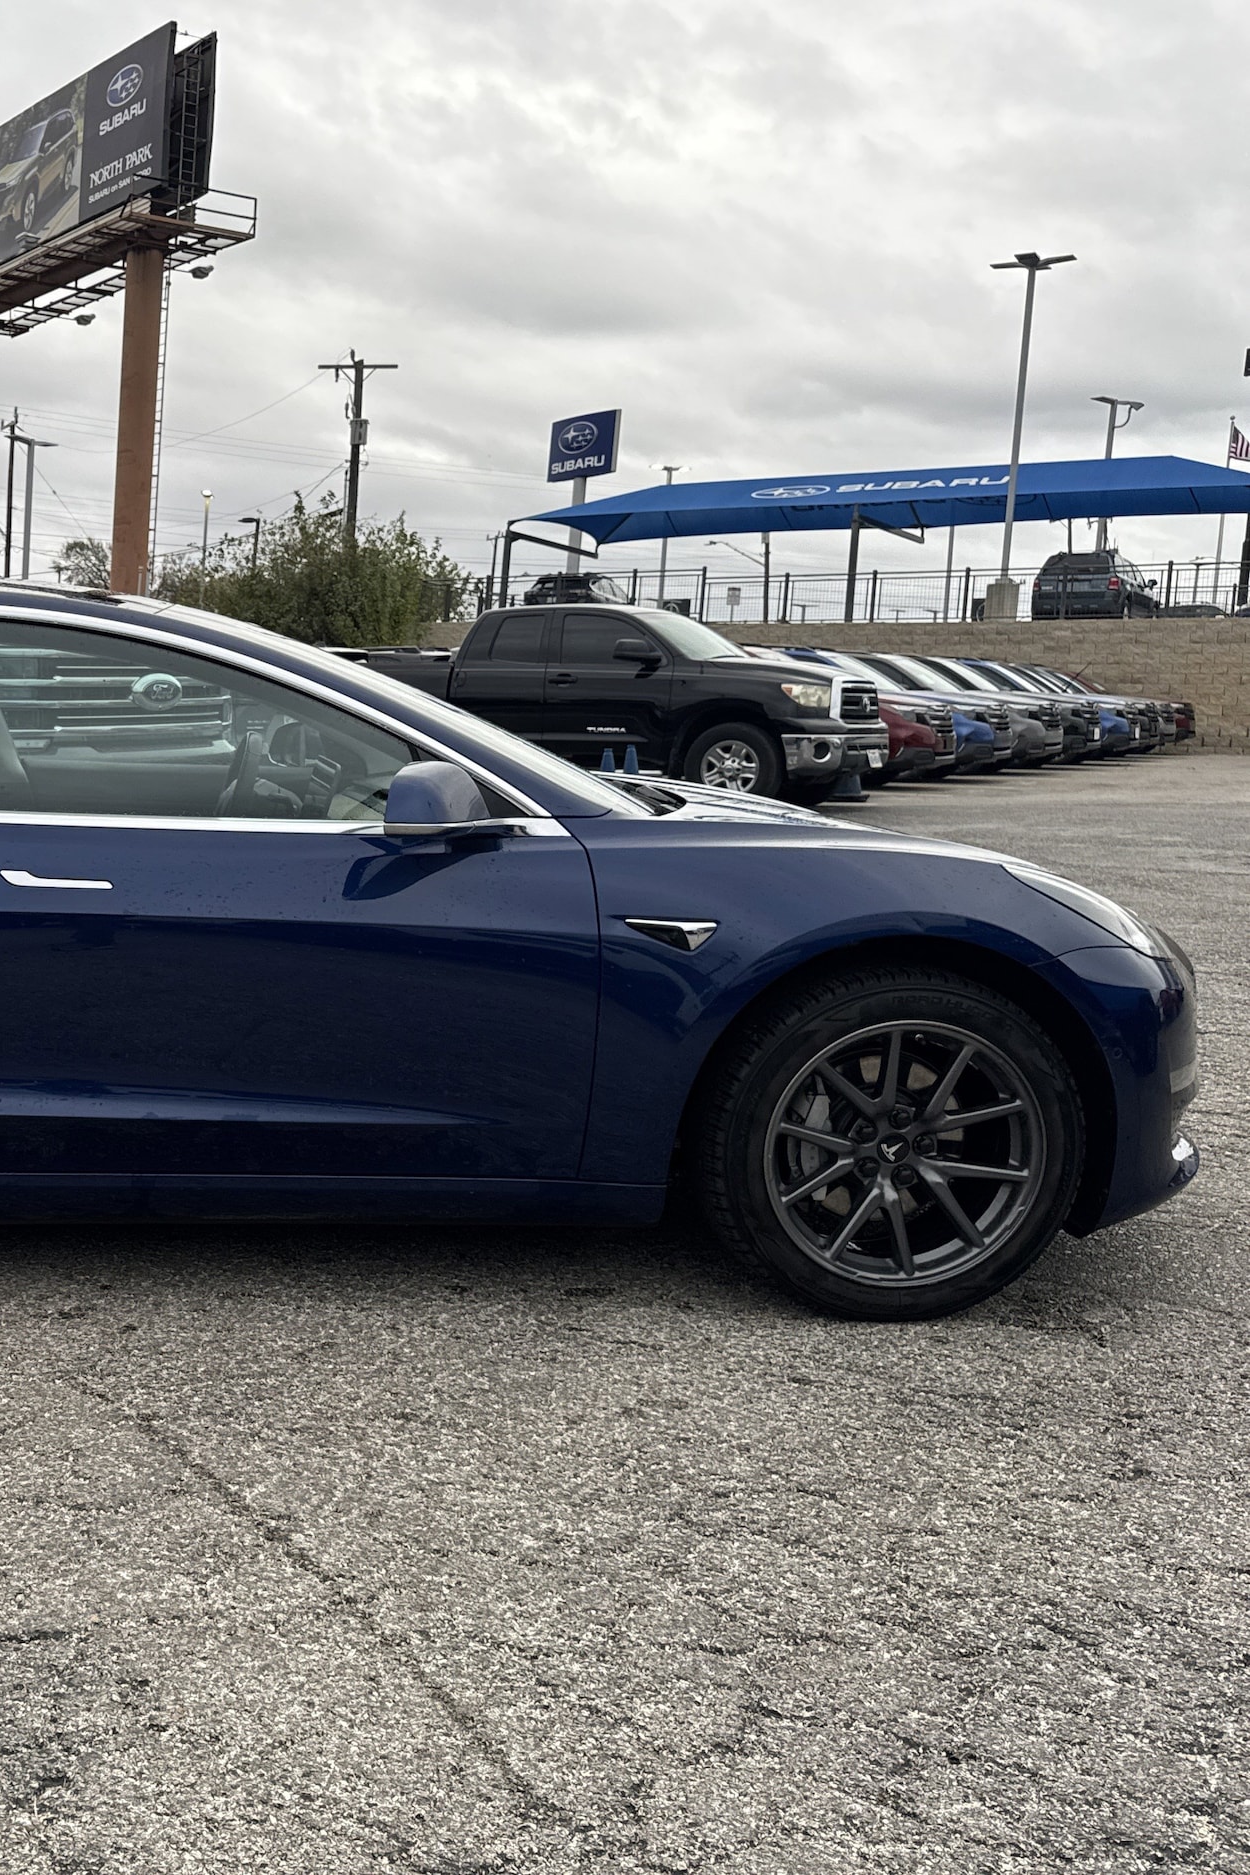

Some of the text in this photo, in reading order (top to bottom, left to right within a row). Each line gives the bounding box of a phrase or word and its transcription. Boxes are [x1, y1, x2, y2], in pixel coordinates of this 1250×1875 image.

[99, 98, 147, 136] SUBARU
[89, 143, 153, 189] NORTH PARK
[88, 186, 110, 204] SUBARU
[130, 166, 152, 181] EDRO
[551, 454, 605, 474] SUBARU
[835, 475, 1010, 493] SUBARU
[586, 726, 626, 734] TUNDRA
